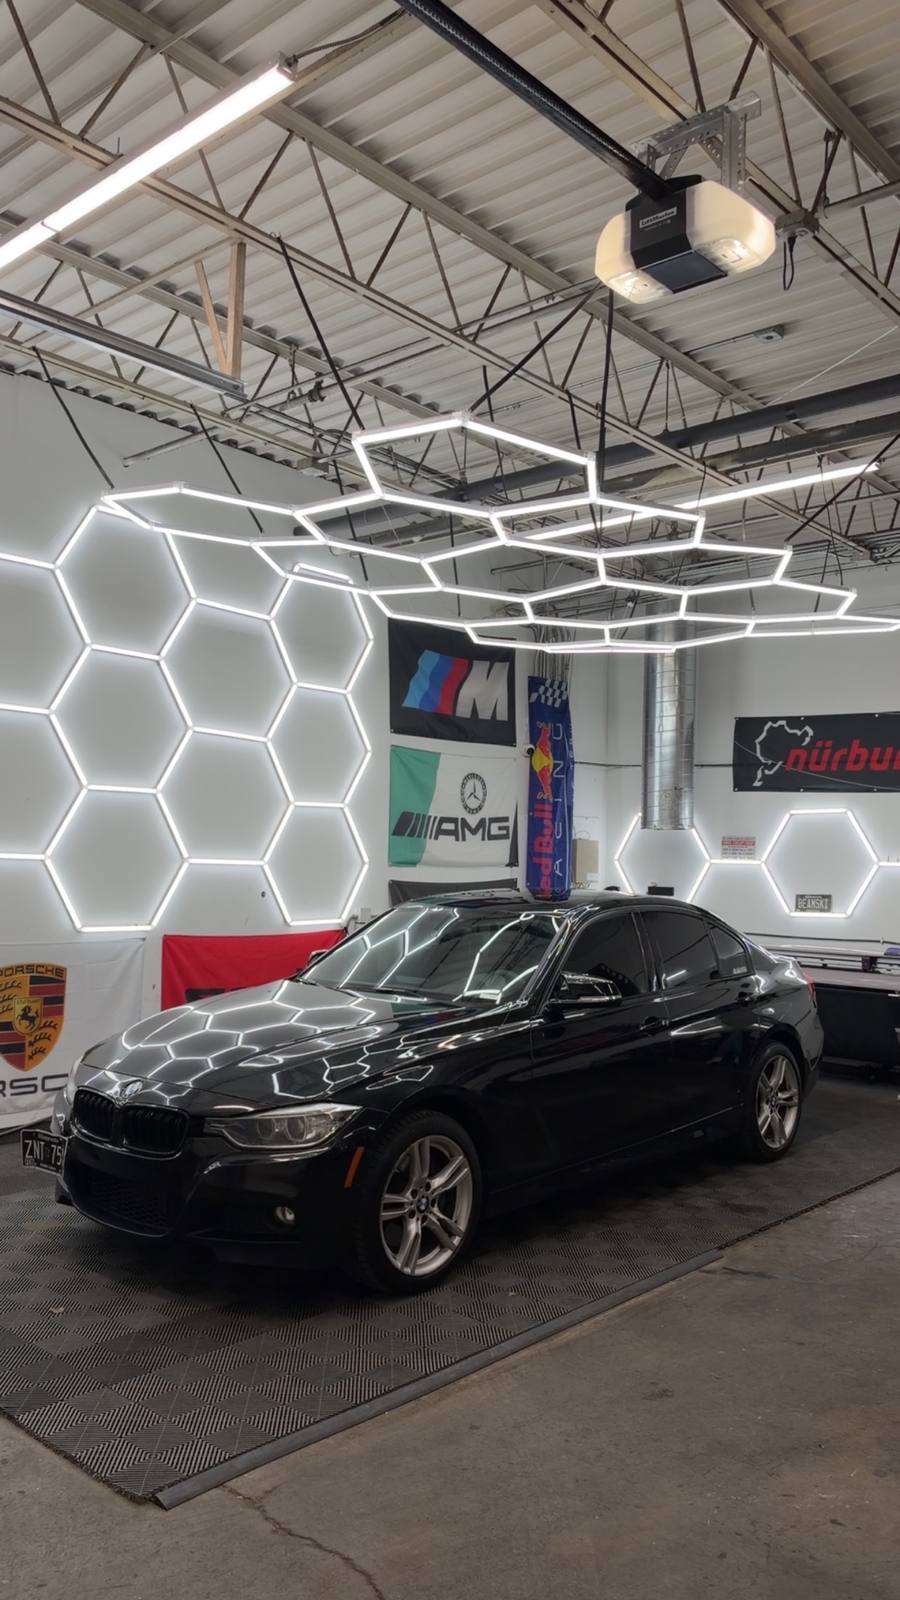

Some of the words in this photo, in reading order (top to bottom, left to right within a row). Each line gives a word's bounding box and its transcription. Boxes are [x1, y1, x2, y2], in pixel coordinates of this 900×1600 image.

[553, 723, 565, 894] ACING
[433, 816, 510, 842] AMG
[533, 803, 554, 851] Bull
[0, 1073, 68, 1097] SC
[24, 1139, 45, 1160] ZNT
[51, 1144, 64, 1166] 75
